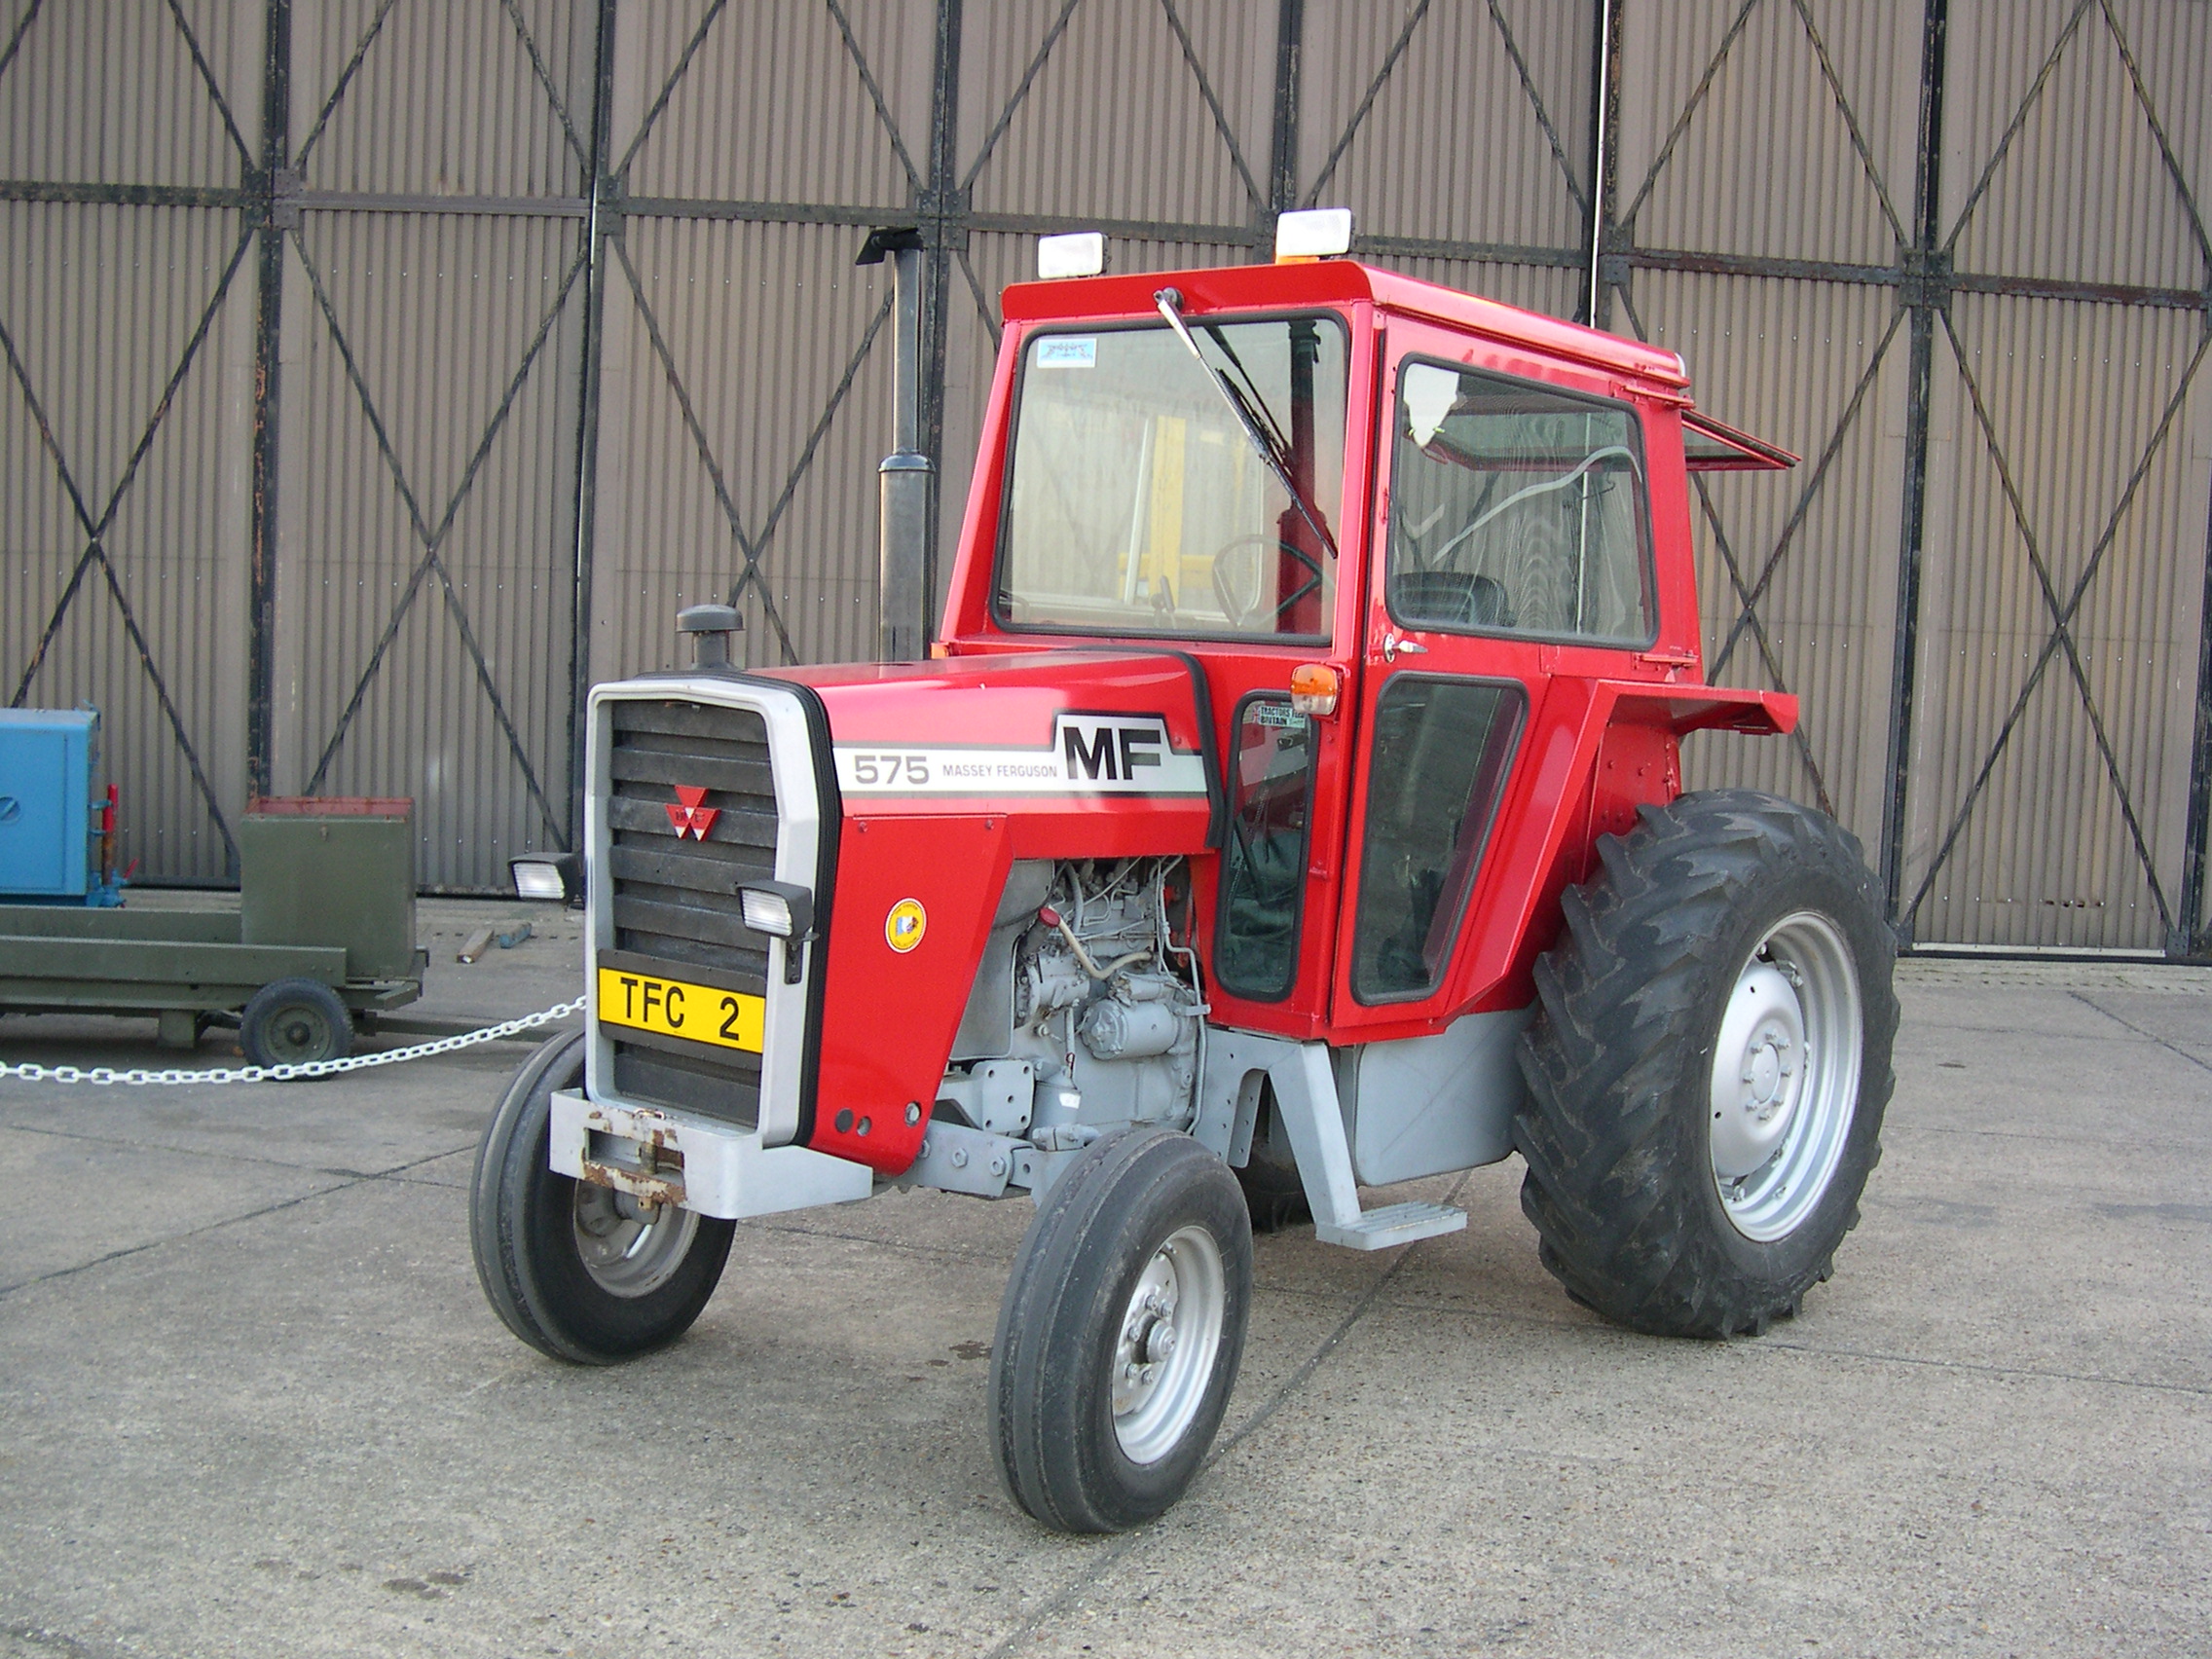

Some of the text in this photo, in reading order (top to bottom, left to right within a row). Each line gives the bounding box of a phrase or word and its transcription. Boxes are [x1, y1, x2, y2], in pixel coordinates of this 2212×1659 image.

[1261, 707, 1290, 718] TRACTORS
[1261, 716, 1287, 725] BRITAIN
[1063, 726, 1161, 780] MF
[854, 755, 1057, 785] 575 MASSEY FERGUSON
[620, 977, 739, 1041] TFC 2
